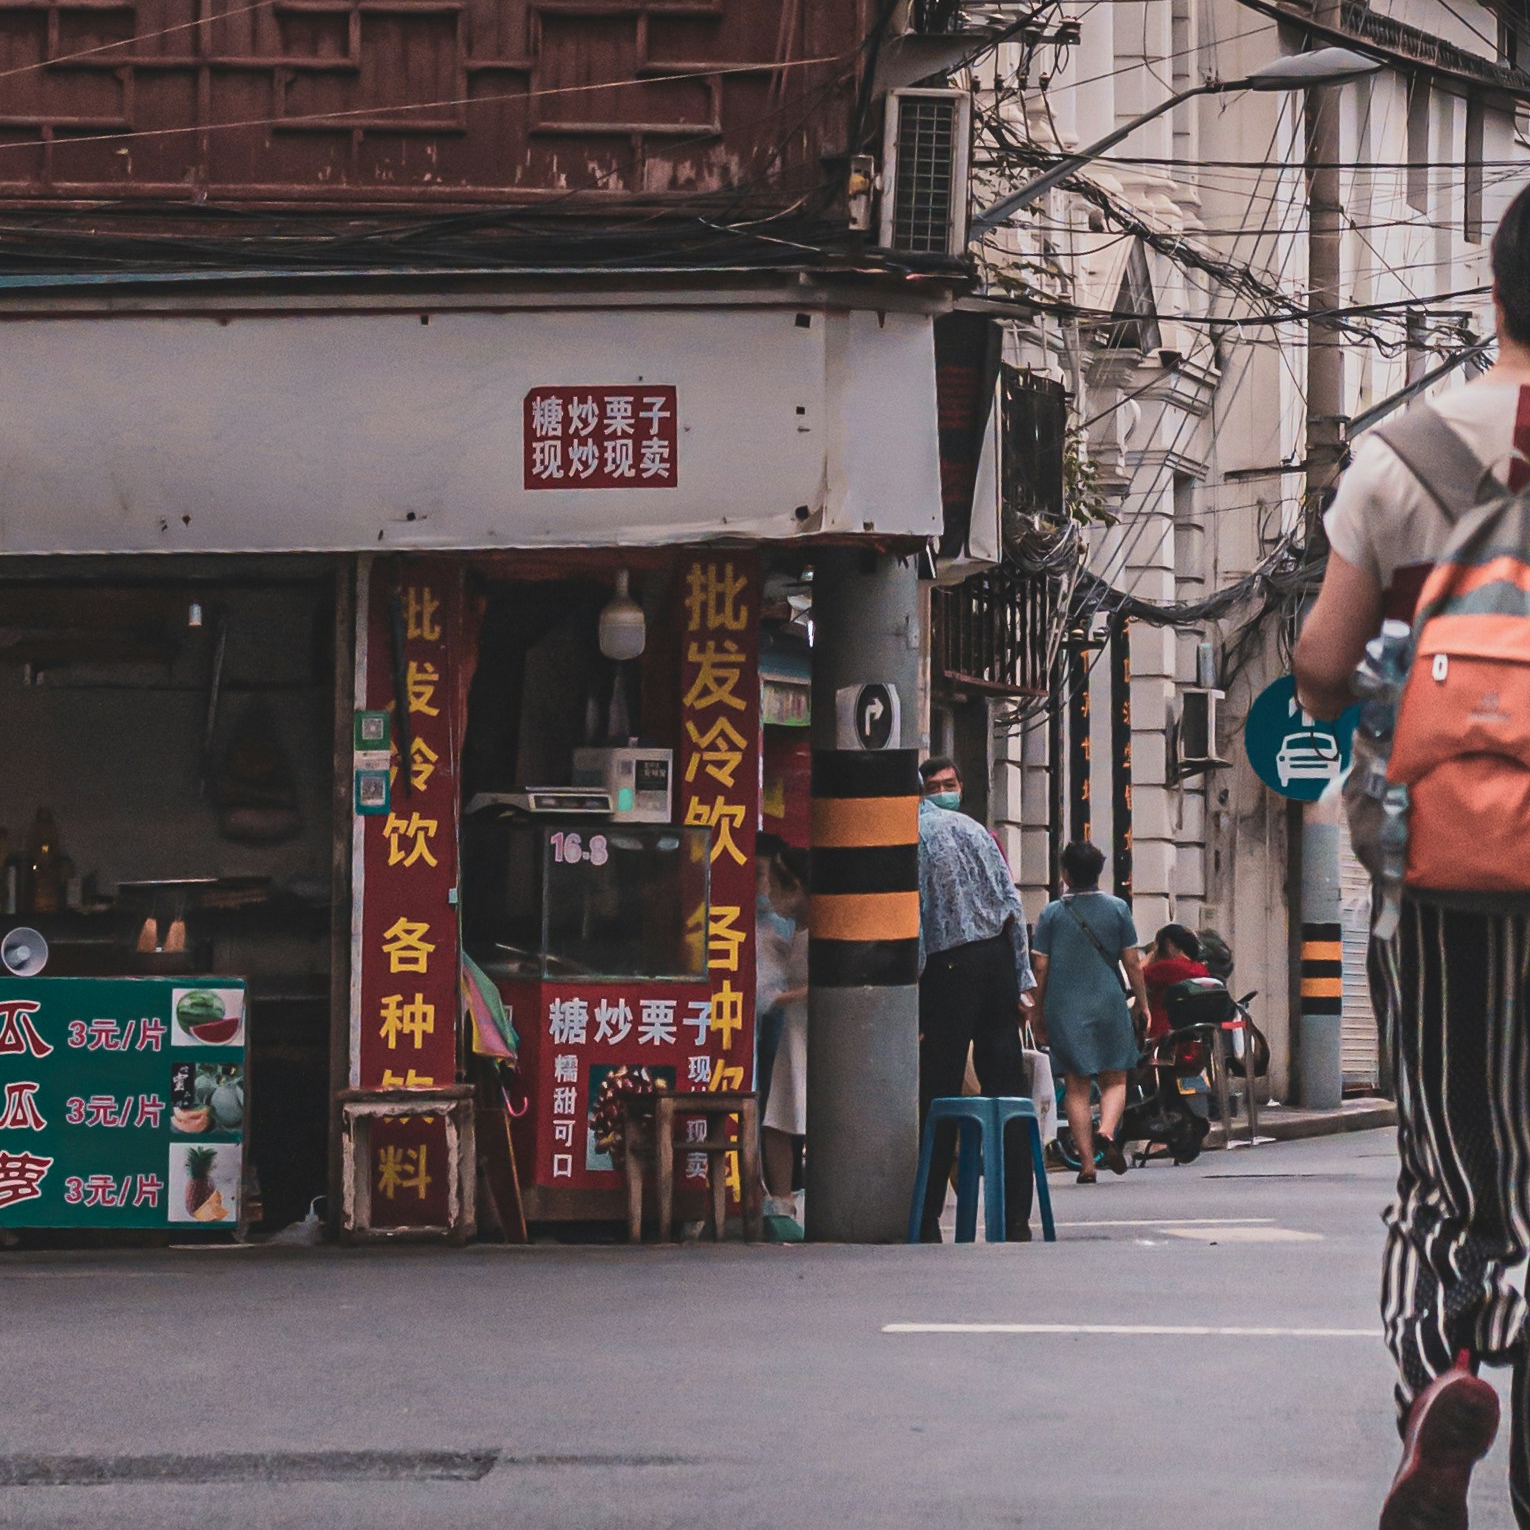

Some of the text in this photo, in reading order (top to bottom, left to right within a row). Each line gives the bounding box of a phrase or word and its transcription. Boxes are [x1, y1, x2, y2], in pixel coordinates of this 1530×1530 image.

[532, 396, 671, 438] 糖炒栗子
[531, 436, 671, 480] 现炒现卖
[551, 831, 608, 866] 16.8
[67, 1018, 167, 1051] 3元/片
[549, 998, 711, 1046] 糖炒栗子
[65, 1094, 165, 1127] 3元/片
[553, 1053, 578, 1179] 糯甜可口
[686, 1055, 711, 1180] 现现卖
[64, 1174, 163, 1207] 3元/片
